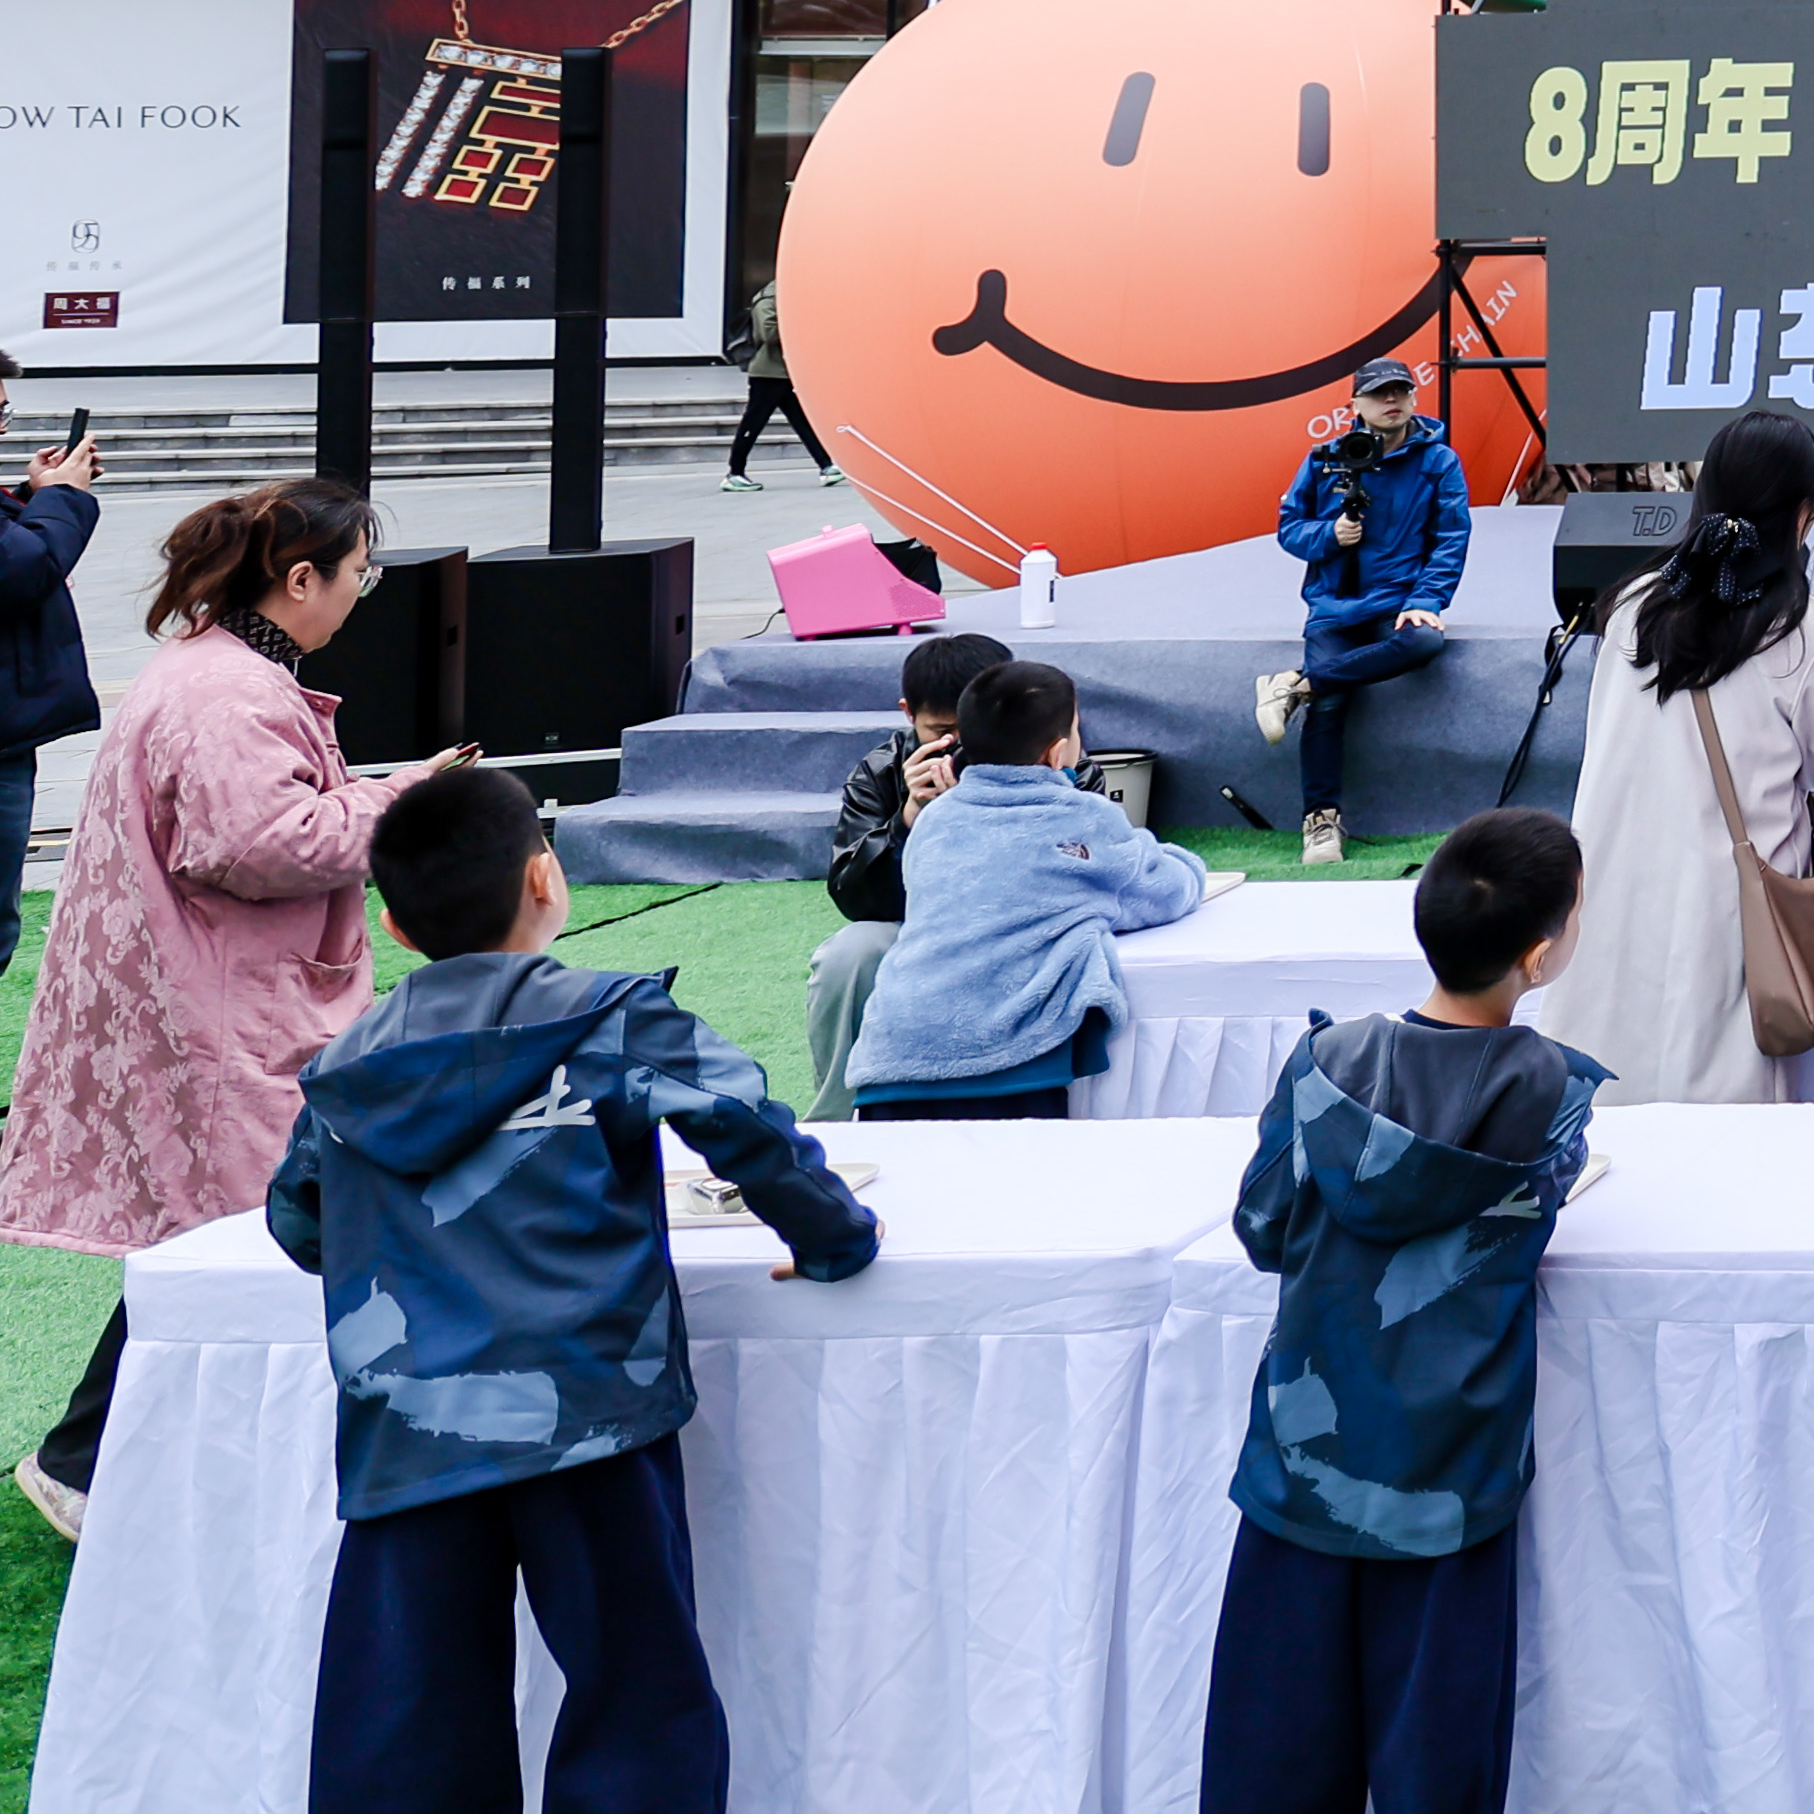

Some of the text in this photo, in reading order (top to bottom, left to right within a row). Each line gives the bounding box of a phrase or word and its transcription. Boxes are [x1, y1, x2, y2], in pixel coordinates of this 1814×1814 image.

[66, 105, 123, 129] TAI
[140, 104, 242, 130] FOOK
[1522, 57, 1796, 188] 8周年
[442, 275, 531, 291] 传福系列
